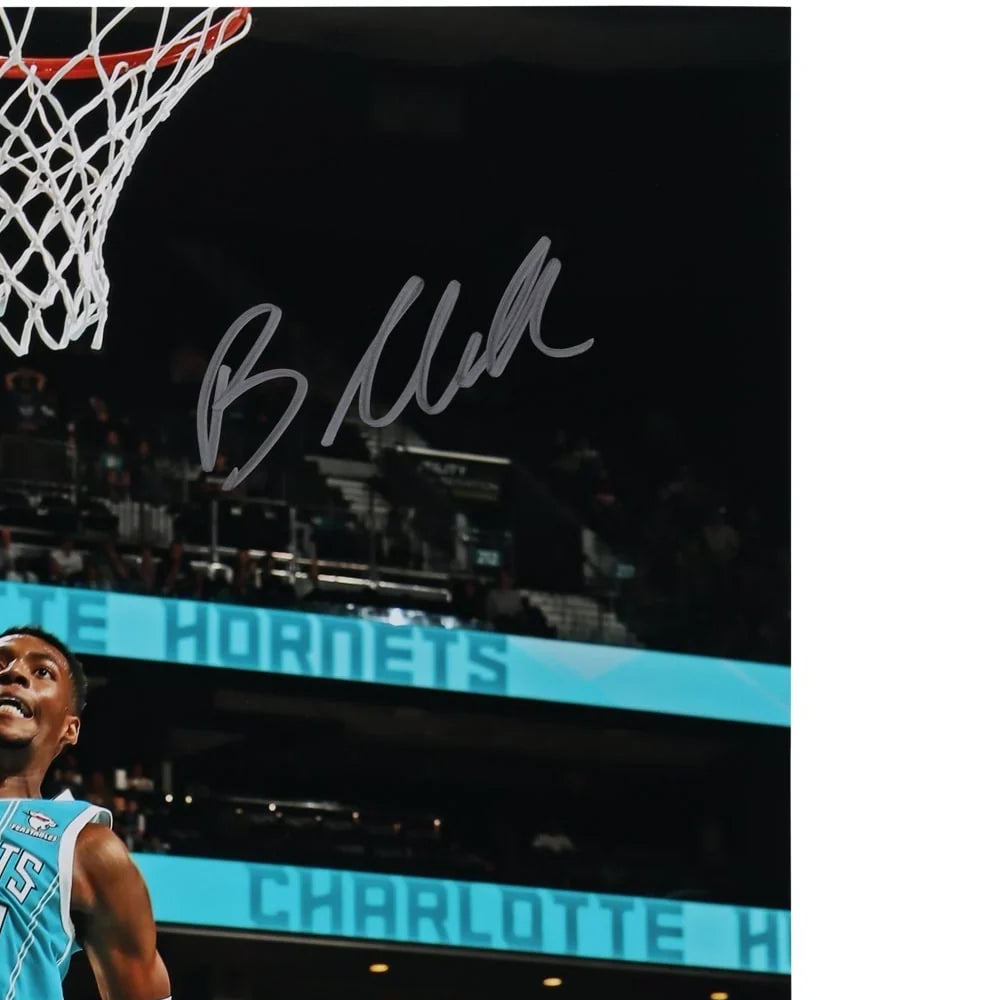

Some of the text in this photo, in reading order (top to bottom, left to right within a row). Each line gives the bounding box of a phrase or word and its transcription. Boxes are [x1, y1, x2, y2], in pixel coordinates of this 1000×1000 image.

[164, 601, 508, 693] HORNETS
[248, 866, 791, 972] CHARLOTTE H
